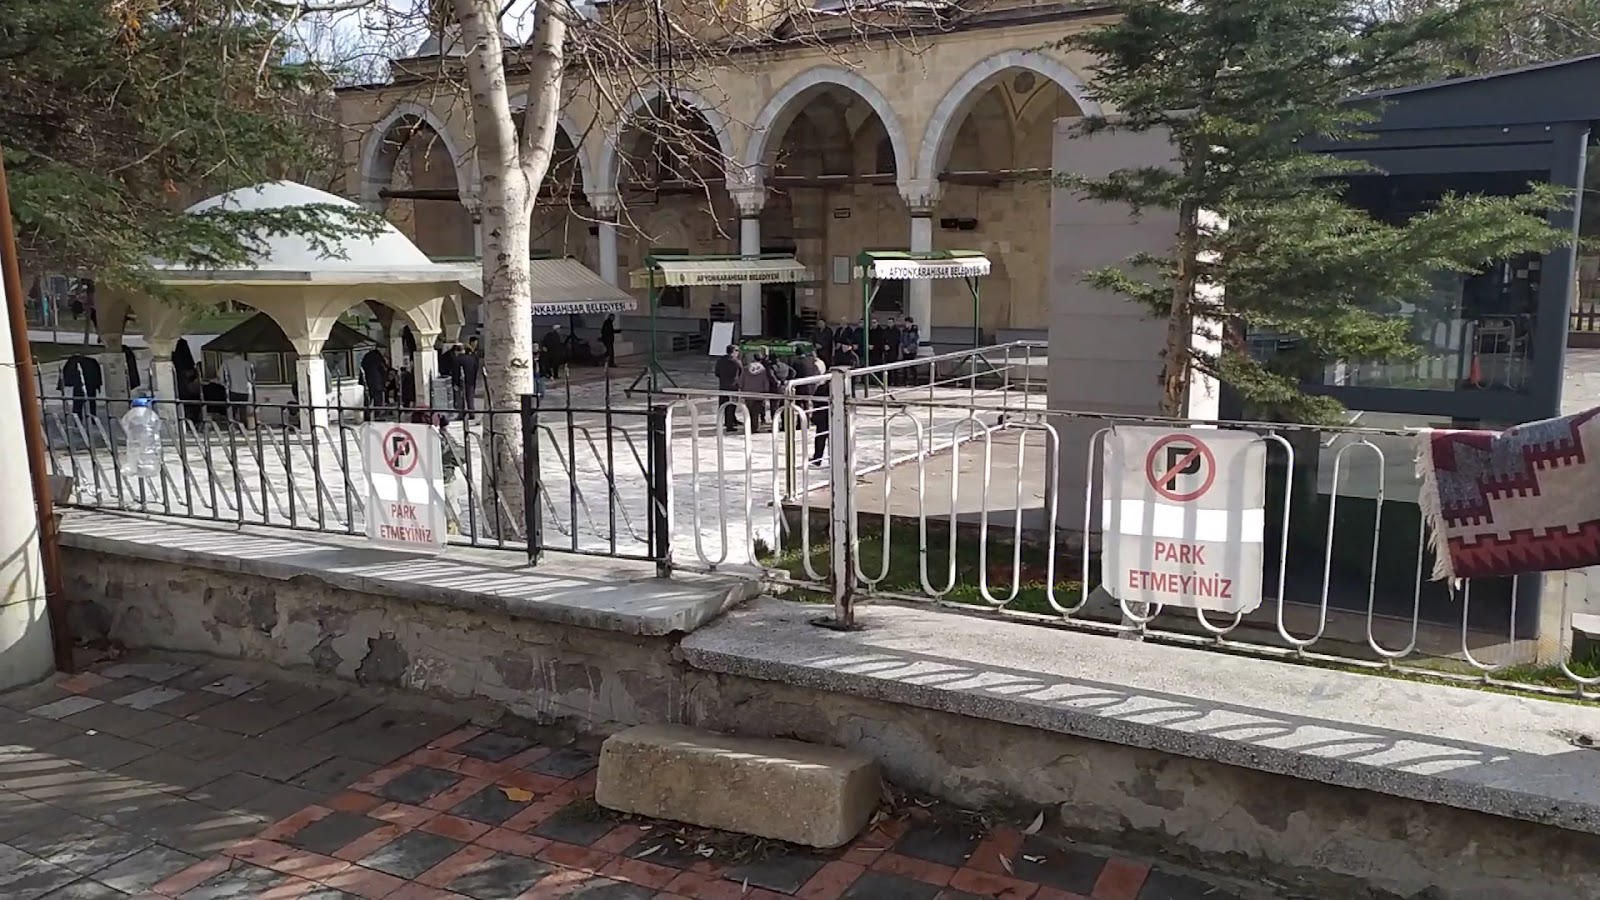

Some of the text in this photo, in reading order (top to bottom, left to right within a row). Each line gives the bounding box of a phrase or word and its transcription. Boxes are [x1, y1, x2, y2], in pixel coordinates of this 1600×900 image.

[1166, 446, 1201, 491] P
[391, 503, 417, 520] PARK
[380, 524, 432, 543] ETMEYİNİZ
[1154, 541, 1206, 565] PARK
[1128, 568, 1233, 599] ETMEYİNİZ
